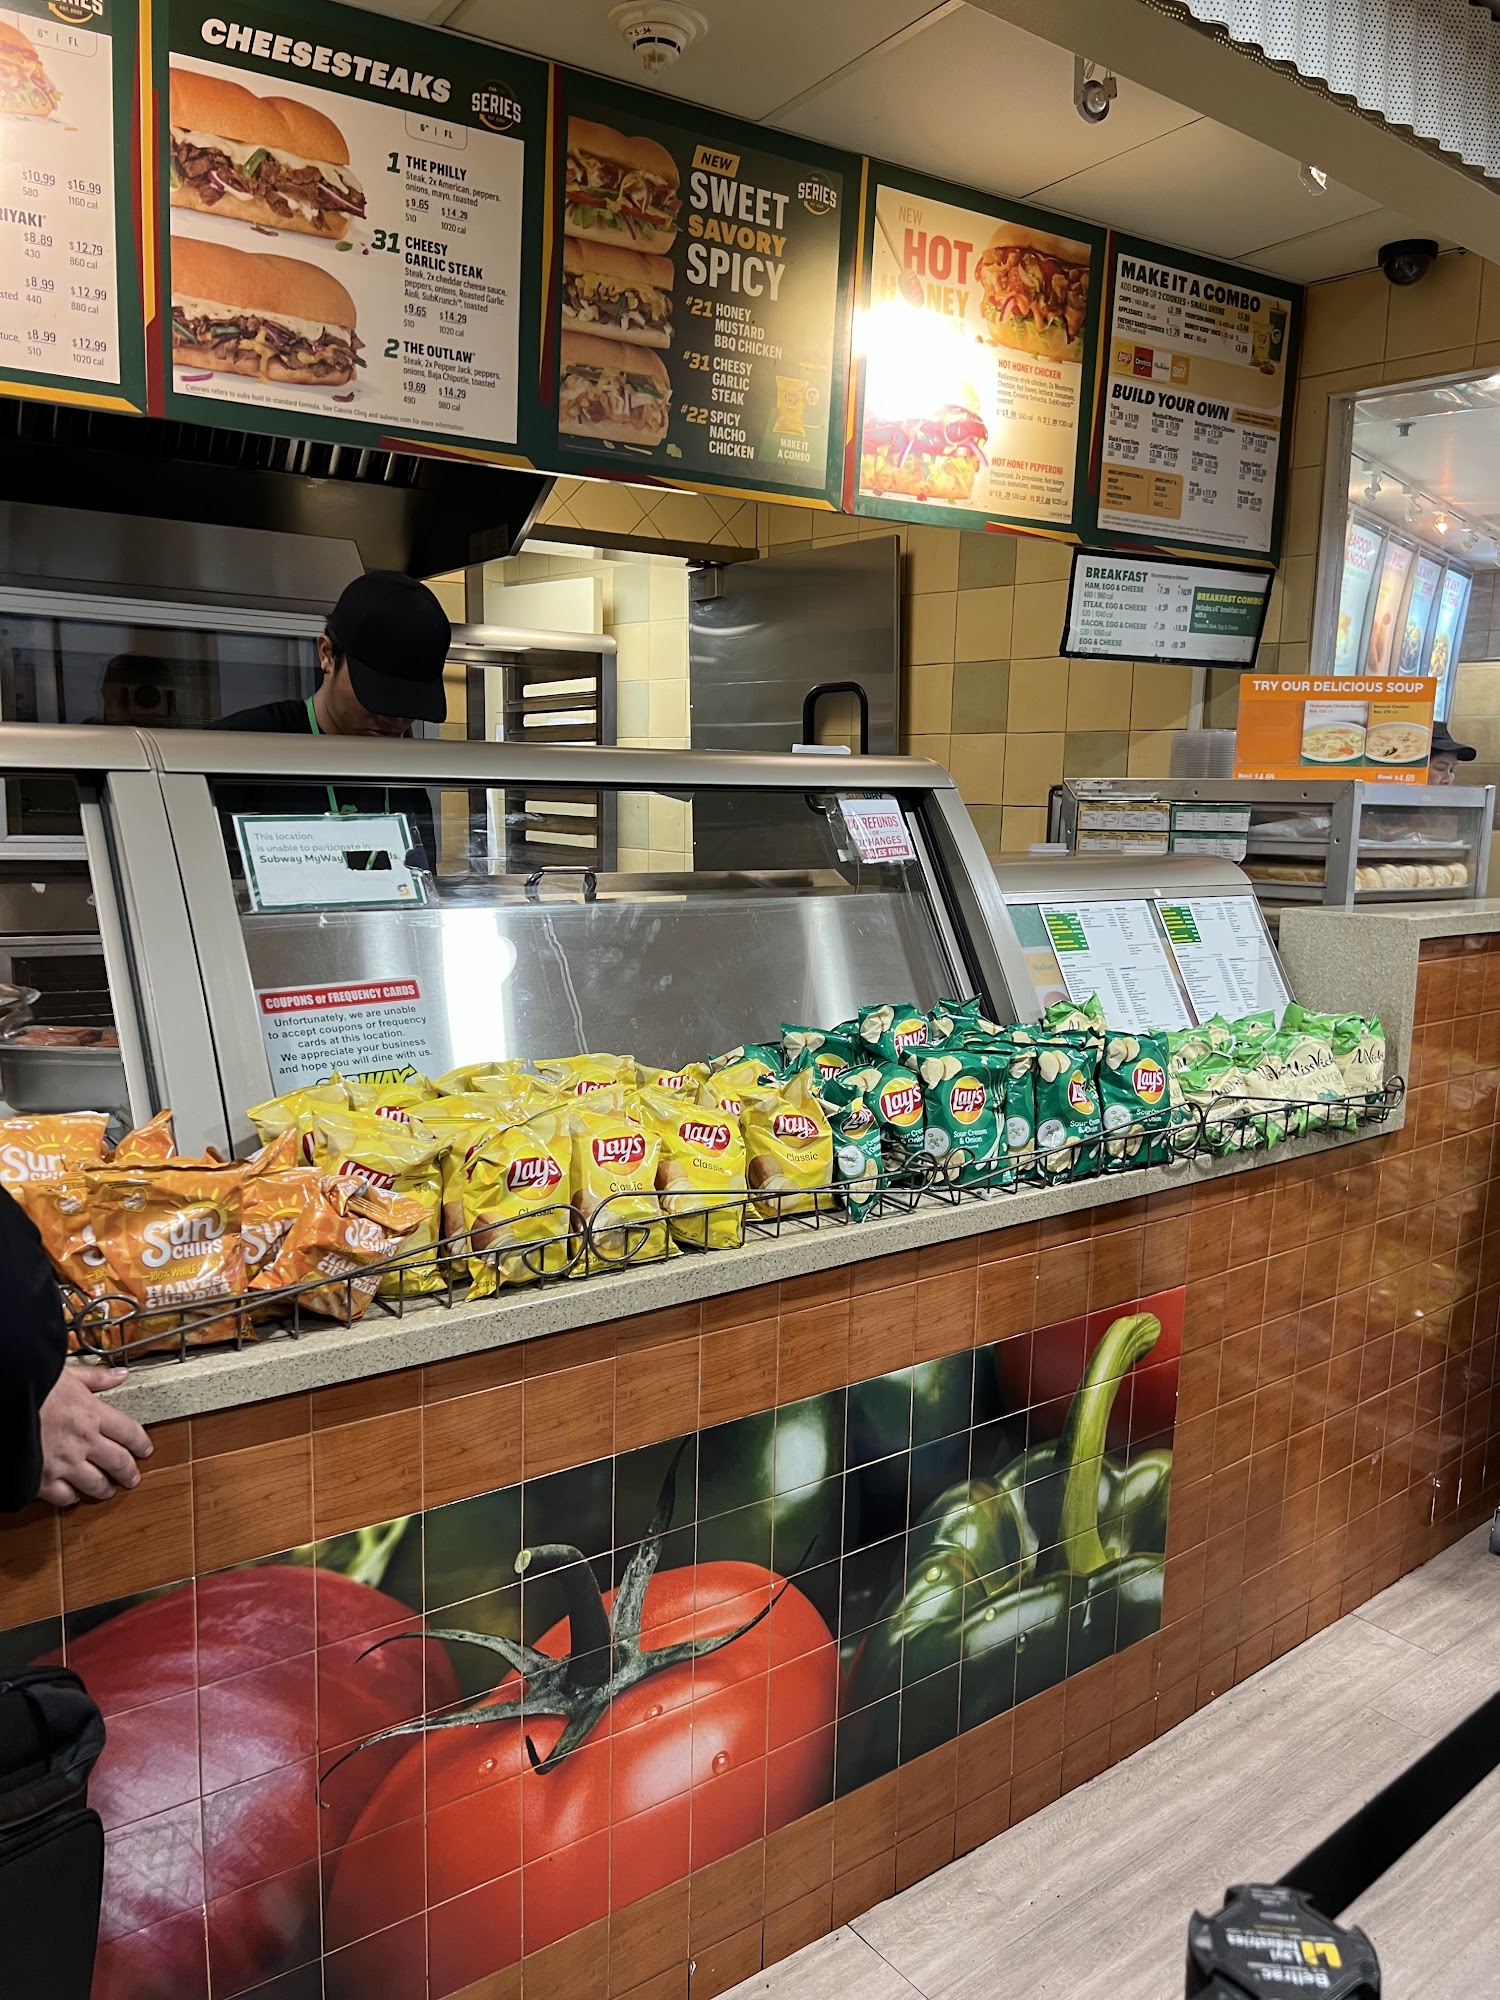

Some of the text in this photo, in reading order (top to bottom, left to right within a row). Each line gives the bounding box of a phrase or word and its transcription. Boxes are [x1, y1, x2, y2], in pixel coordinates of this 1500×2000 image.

[200, 17, 452, 104] CHEESESTEAKS
[471, 92, 522, 124] SERIES
[387, 152, 467, 181] 1 THE PHILLY
[701, 152, 733, 171] NEW
[22, 169, 102, 195] $10.99 $16.99
[405, 171, 502, 203] Steak, 2x American, peppers,
[22, 187, 98, 209] 580 1160 cal
[689, 171, 790, 230] SWEET
[798, 182, 837, 208] SERIES
[899, 206, 923, 225] NEW
[24, 232, 103, 256] $8.89 $12.79
[371, 229, 448, 256] 31 CHEESY
[688, 214, 787, 258] SAVORY
[24, 249, 98, 270] 430 860 cal
[405, 252, 483, 280] GARLIC STEAK
[903, 227, 974, 285] HOT
[686, 243, 786, 302] SPICY
[25, 276, 107, 301] $8.99 $12.99
[1121, 260, 1261, 313] MAKE IT A COMBO
[404, 303, 467, 324] $9.65 $14.29
[686, 296, 751, 322] #21 HONEY
[715, 319, 765, 340] MUSTARD
[27, 329, 107, 352] $8.99 $12.99
[384, 338, 400, 359] 2
[403, 341, 425, 355] THE
[714, 335, 782, 360] BBQ CHICKEN
[683, 350, 753, 376] #31 CHEESY
[998, 359, 1062, 380] HOT HONEY CHICKEN
[403, 381, 467, 399] $9.69 $14.29
[712, 373, 750, 392] GARLIC
[711, 388, 745, 406] STEAK
[1112, 383, 1156, 405] BUILD
[1158, 393, 1195, 414] YOUR
[1196, 402, 1230, 421] OWN
[680, 404, 741, 427] #22 SPICY
[709, 425, 746, 443] NACHO
[780, 438, 809, 451] MAKE IT
[708, 440, 755, 460] CHICKEN
[777, 449, 811, 463] A COMBO
[992, 457, 1064, 475] HOT HONEY PEPPERONI
[1085, 567, 1148, 583] BREAKFAST
[1085, 582, 1101, 591] HAM,
[1102, 583, 1115, 591] EGG
[1121, 585, 1144, 593] CHEESE
[1197, 592, 1236, 604] BREAKFAST
[1099, 639, 1122, 647] CHEESE
[1253, 680, 1424, 693] TRY OUR DELICIOUS SOUP
[862, 815, 899, 829] REFUNDS
[254, 832, 313, 841] This location
[256, 844, 265, 852] is
[266, 843, 298, 851] unable
[312, 843, 361, 853] participate
[888, 847, 908, 856] FINAL
[260, 854, 343, 864] Subway MyWay
[265, 985, 415, 1009] COUPONS or FREQUENCY CARDS
[274, 1013, 347, 1028] Unfortunately,
[366, 1010, 381, 1018] are
[384, 1005, 416, 1016] unable
[268, 1032, 279, 1040] to
[282, 1028, 316, 1039] accept
[319, 1023, 363, 1036] coupons
[378, 1016, 427, 1029] frequency
[298, 1028, 406, 1048] cards at this location.
[280, 1038, 426, 1062] We appreciate your business
[279, 1049, 434, 1075] and hope you will dine with us.
[886, 1086, 922, 1116] Lay's
[953, 1087, 983, 1112] Lay's
[953, 1128, 987, 1138] Sour Cream
[597, 1134, 642, 1164] Lay's
[786, 1152, 819, 1162] Classic
[693, 1158, 724, 1173] Classic
[609, 1181, 643, 1193] Classic
[141, 1213, 227, 1267] Sun
[171, 1238, 224, 1260] CHIPS
[359, 1239, 397, 1257] CHIPS
[1261, 1968, 1330, 1988] Beltrac
